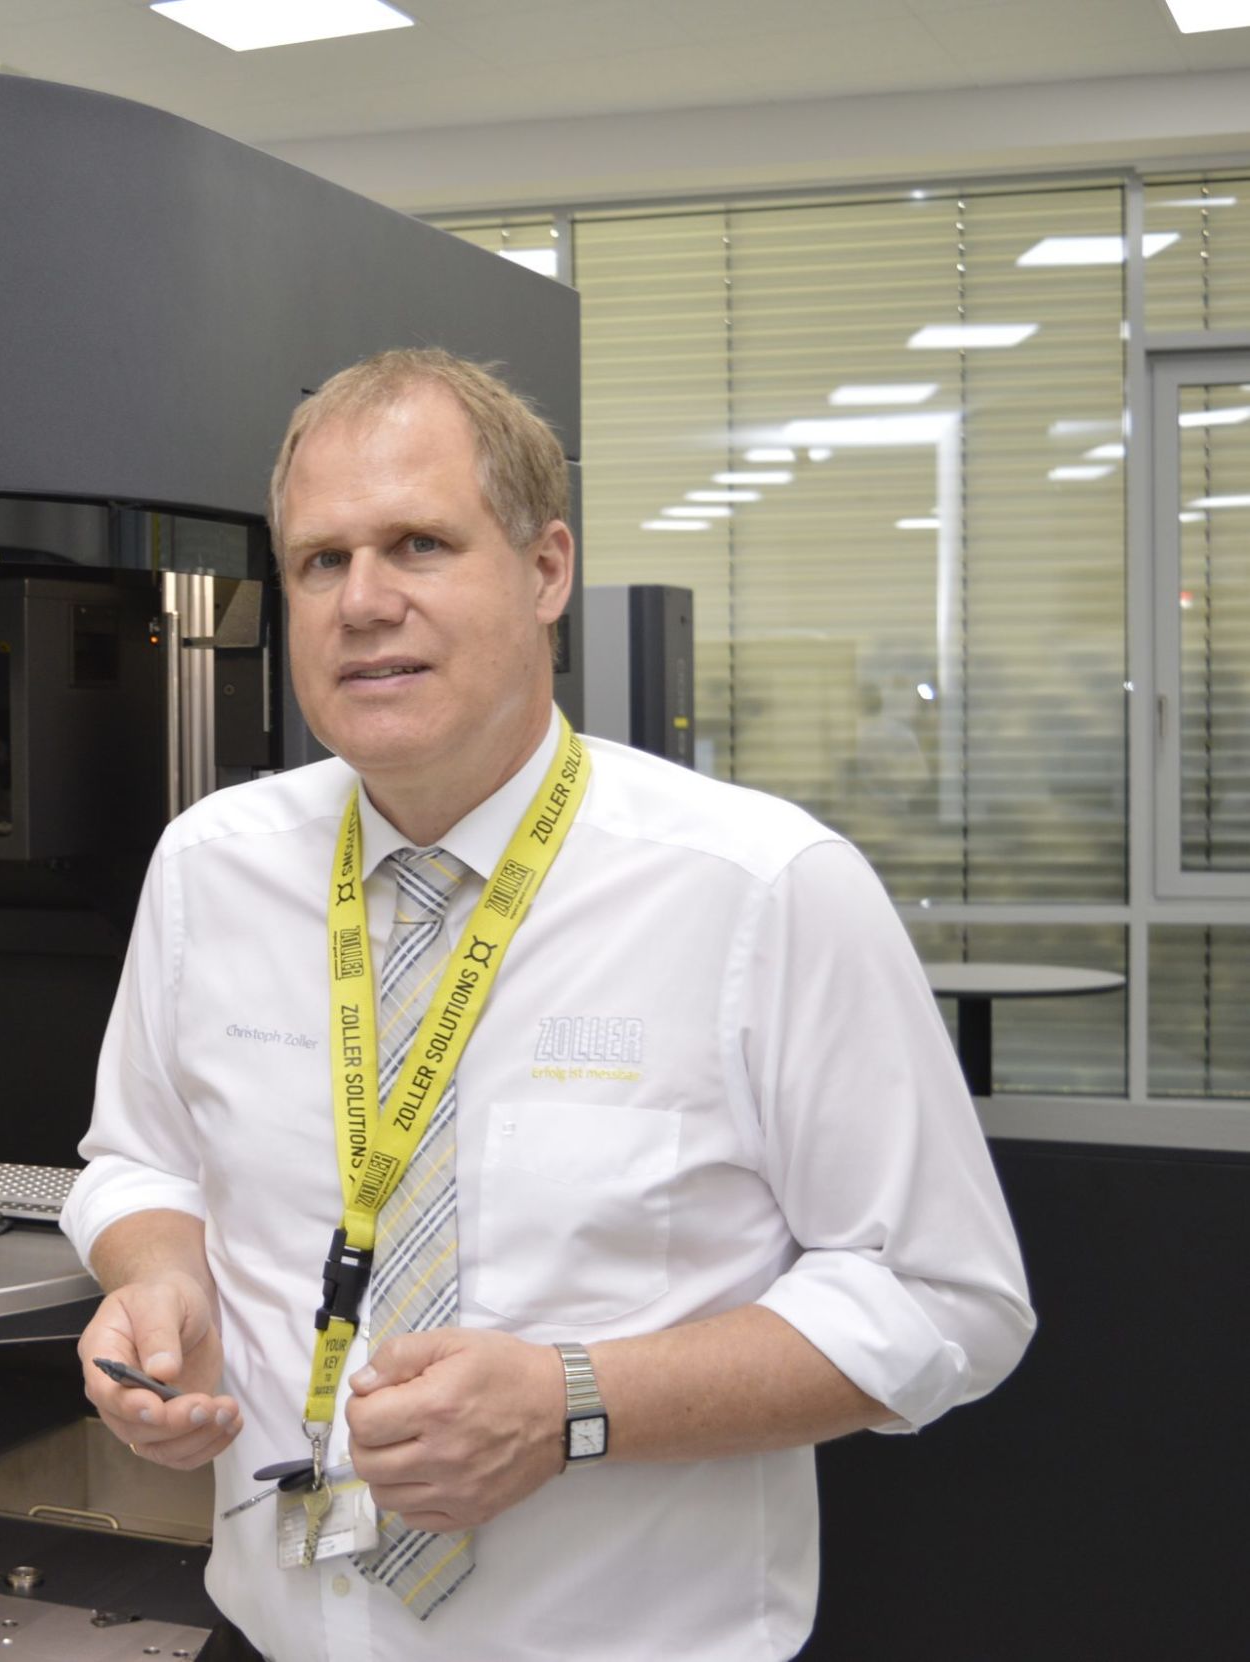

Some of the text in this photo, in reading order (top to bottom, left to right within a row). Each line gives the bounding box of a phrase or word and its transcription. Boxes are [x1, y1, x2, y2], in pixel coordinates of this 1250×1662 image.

[529, 782, 570, 845] ZOLLER
[484, 859, 531, 917] ZOLLER
[283, 1033, 318, 1049] Zoller
[341, 1004, 362, 1067] ZOLLER
[393, 968, 479, 1132] ZOLLER SOLUTIONS
[534, 1017, 644, 1063] ZOLLER
[323, 1355, 340, 1369] KEY
[325, 1337, 347, 1352] YOUR
